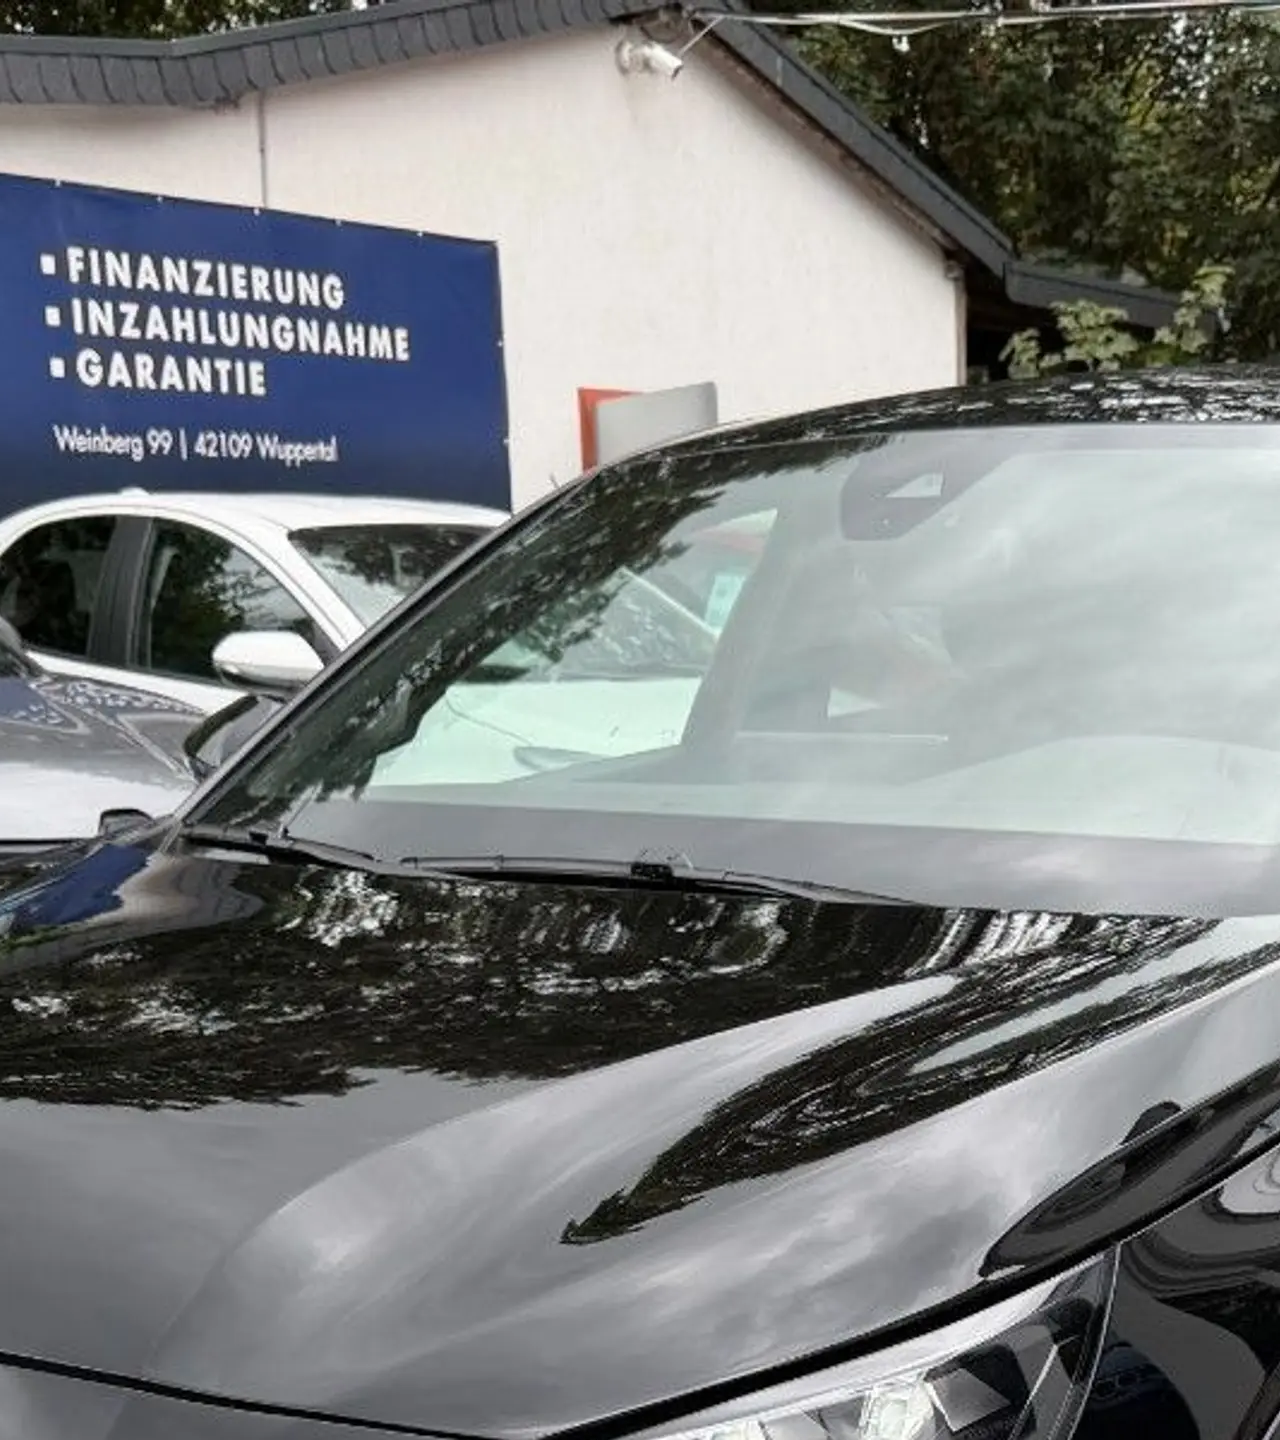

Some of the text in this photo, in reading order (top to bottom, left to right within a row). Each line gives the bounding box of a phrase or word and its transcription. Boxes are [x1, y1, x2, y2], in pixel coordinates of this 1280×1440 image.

[67, 246, 345, 310] FINANZIERUNG
[71, 297, 410, 362] INZAHLUNGNAHME
[76, 347, 267, 397] GARANTIE
[52, 424, 144, 463] Weinberg
[146, 429, 173, 456] 99
[194, 430, 253, 460] 42109
[256, 433, 338, 468] Wuppertal
